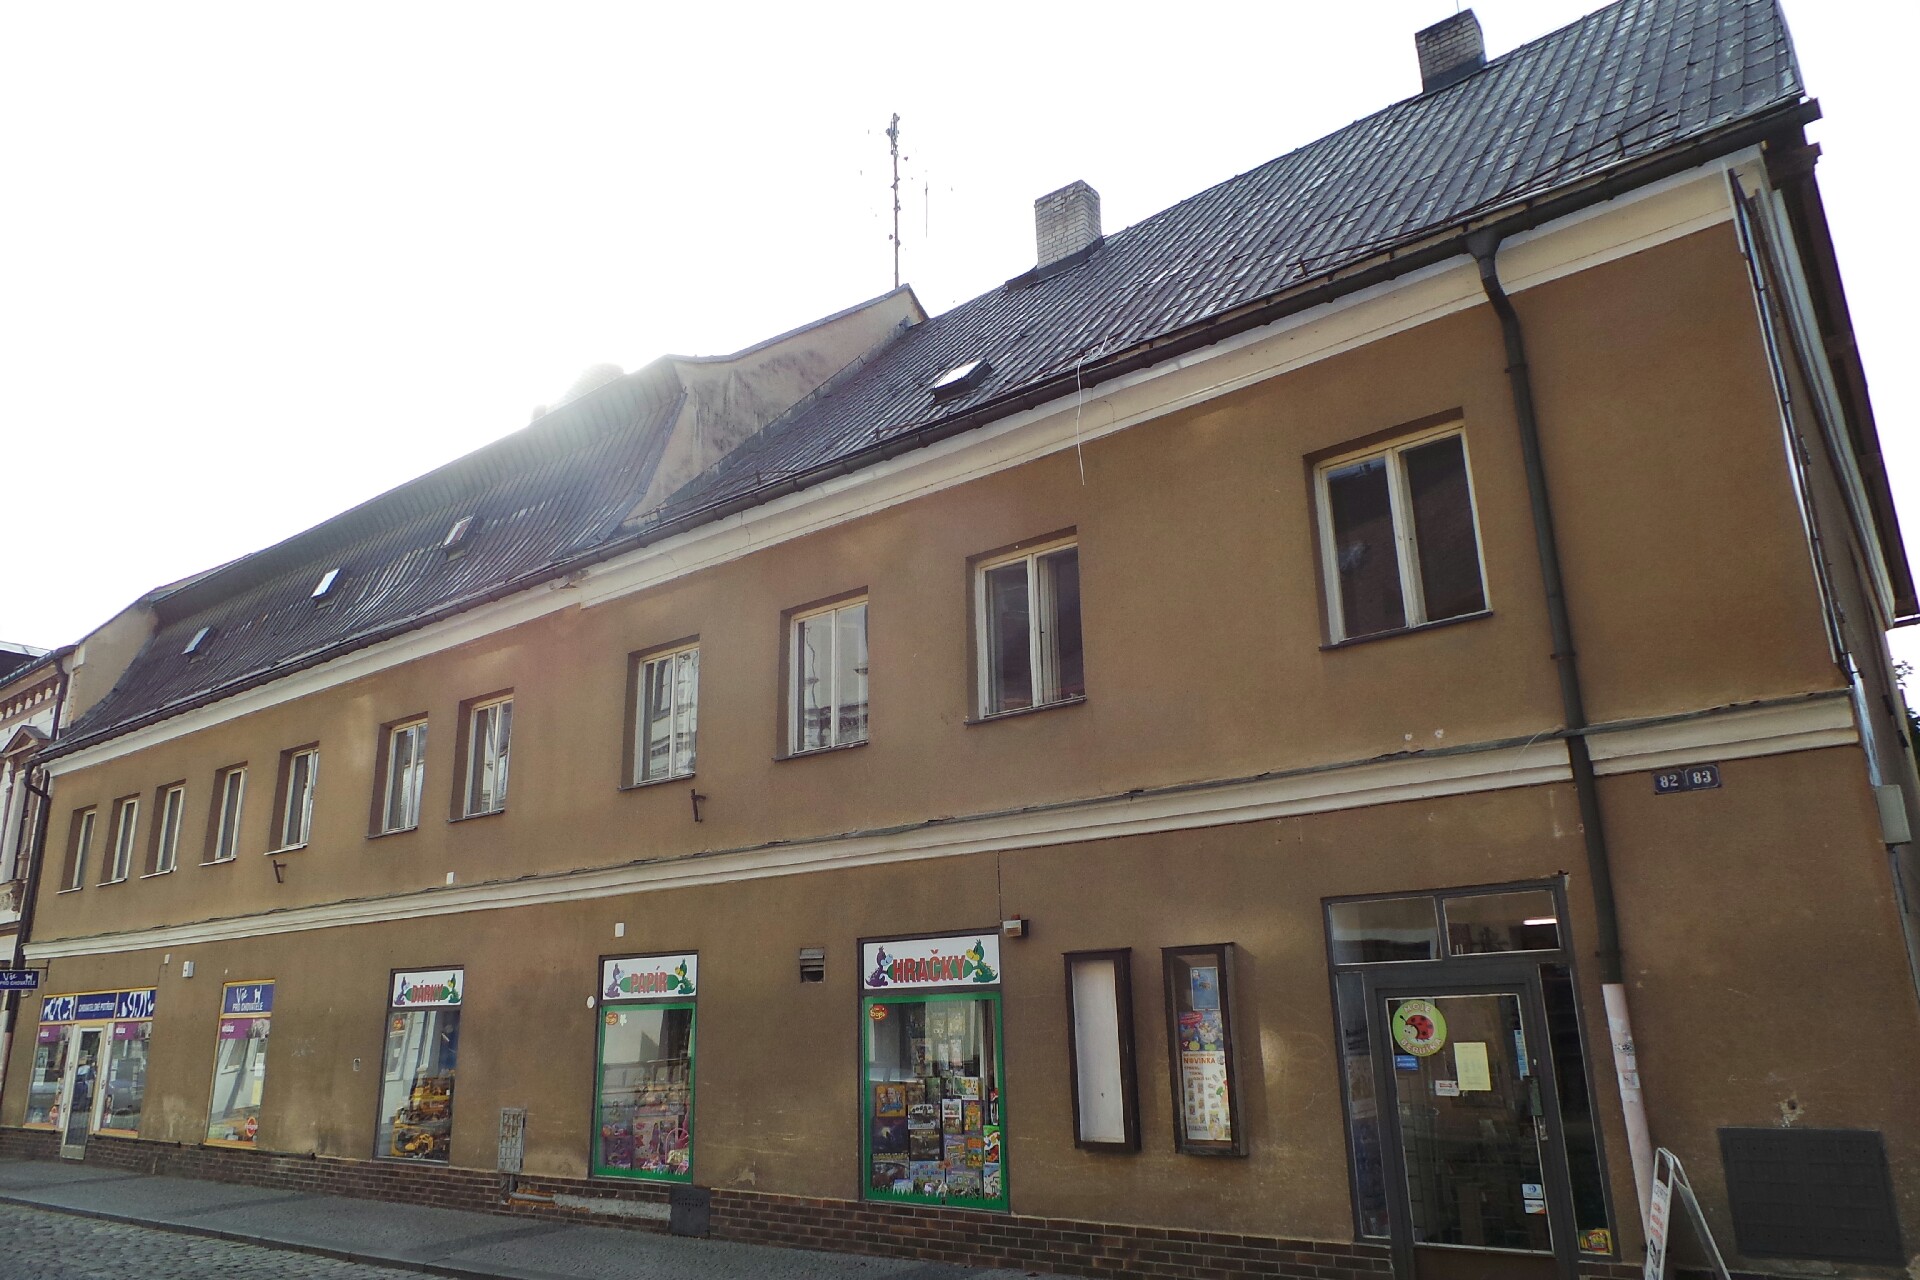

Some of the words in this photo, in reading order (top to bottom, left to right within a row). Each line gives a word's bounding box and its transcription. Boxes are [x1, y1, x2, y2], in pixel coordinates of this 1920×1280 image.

[1659, 774, 1679, 788] 82
[1692, 770, 1712, 784] 83
[892, 948, 966, 983] HRAČKY
[629, 965, 668, 994] PAPÍR
[410, 979, 444, 1003] DÁRKY
[1403, 1003, 1433, 1014] MOJE
